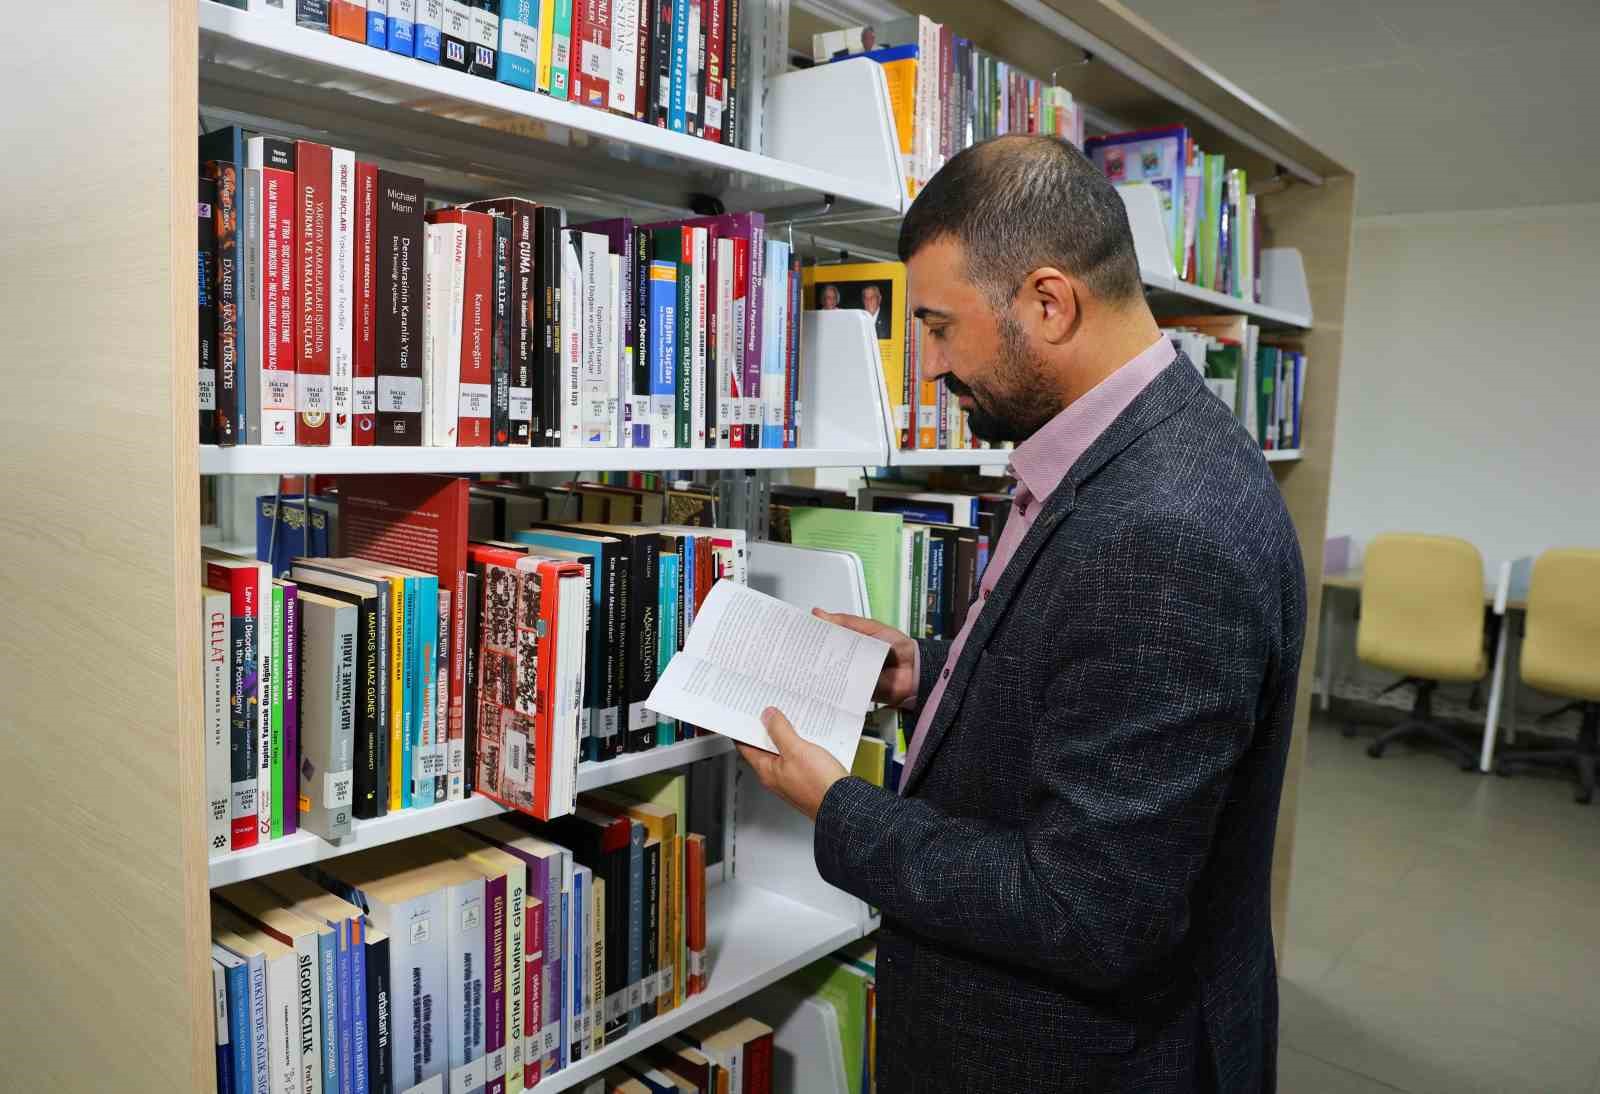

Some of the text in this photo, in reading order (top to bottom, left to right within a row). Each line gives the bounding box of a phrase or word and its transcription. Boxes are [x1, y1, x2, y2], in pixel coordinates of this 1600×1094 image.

[387, 188, 417, 202] Michael
[391, 200, 413, 213] Mann
[315, 201, 324, 243] YARGITAY
[454, 229, 463, 263] YUNAN
[519, 241, 531, 274] CUMA
[303, 186, 316, 359] ÖLDÜRME VE YARALAMA SUÇLARI
[498, 236, 507, 317] Seri Katiller
[223, 259, 236, 390] DARBE ARASI TÜRKİYE
[400, 237, 410, 368] Demokrasinin Karanlık Yüzü
[595, 305, 604, 345] Toplumsal
[471, 327, 485, 369] İçeceğim
[638, 318, 647, 366] Cybercrime
[663, 306, 675, 384] Bilişim Suçları
[748, 309, 756, 352] Psychology
[682, 346, 690, 376] BİLİŞİM
[211, 611, 225, 664] CELLAT
[245, 586, 253, 661] Law and Disorder
[287, 598, 295, 633] TÜRKİYE'DE
[367, 612, 376, 651] MAHPUS
[234, 639, 244, 714] in the Postcolony
[341, 633, 355, 730] HAPİSHANE TARİHİ
[367, 654, 376, 685] YILMAZ
[367, 687, 378, 718] GÜNEY
[491, 896, 504, 993] EĞİTİM BİLİMİNE GİRİŞ
[511, 888, 522, 998] BİLİMİNE GİRİŞ
[299, 954, 314, 1055] SİGORTACILIK
[377, 991, 389, 1049] erbakan'ın
[255, 1037, 267, 1071] SAĞLIK
